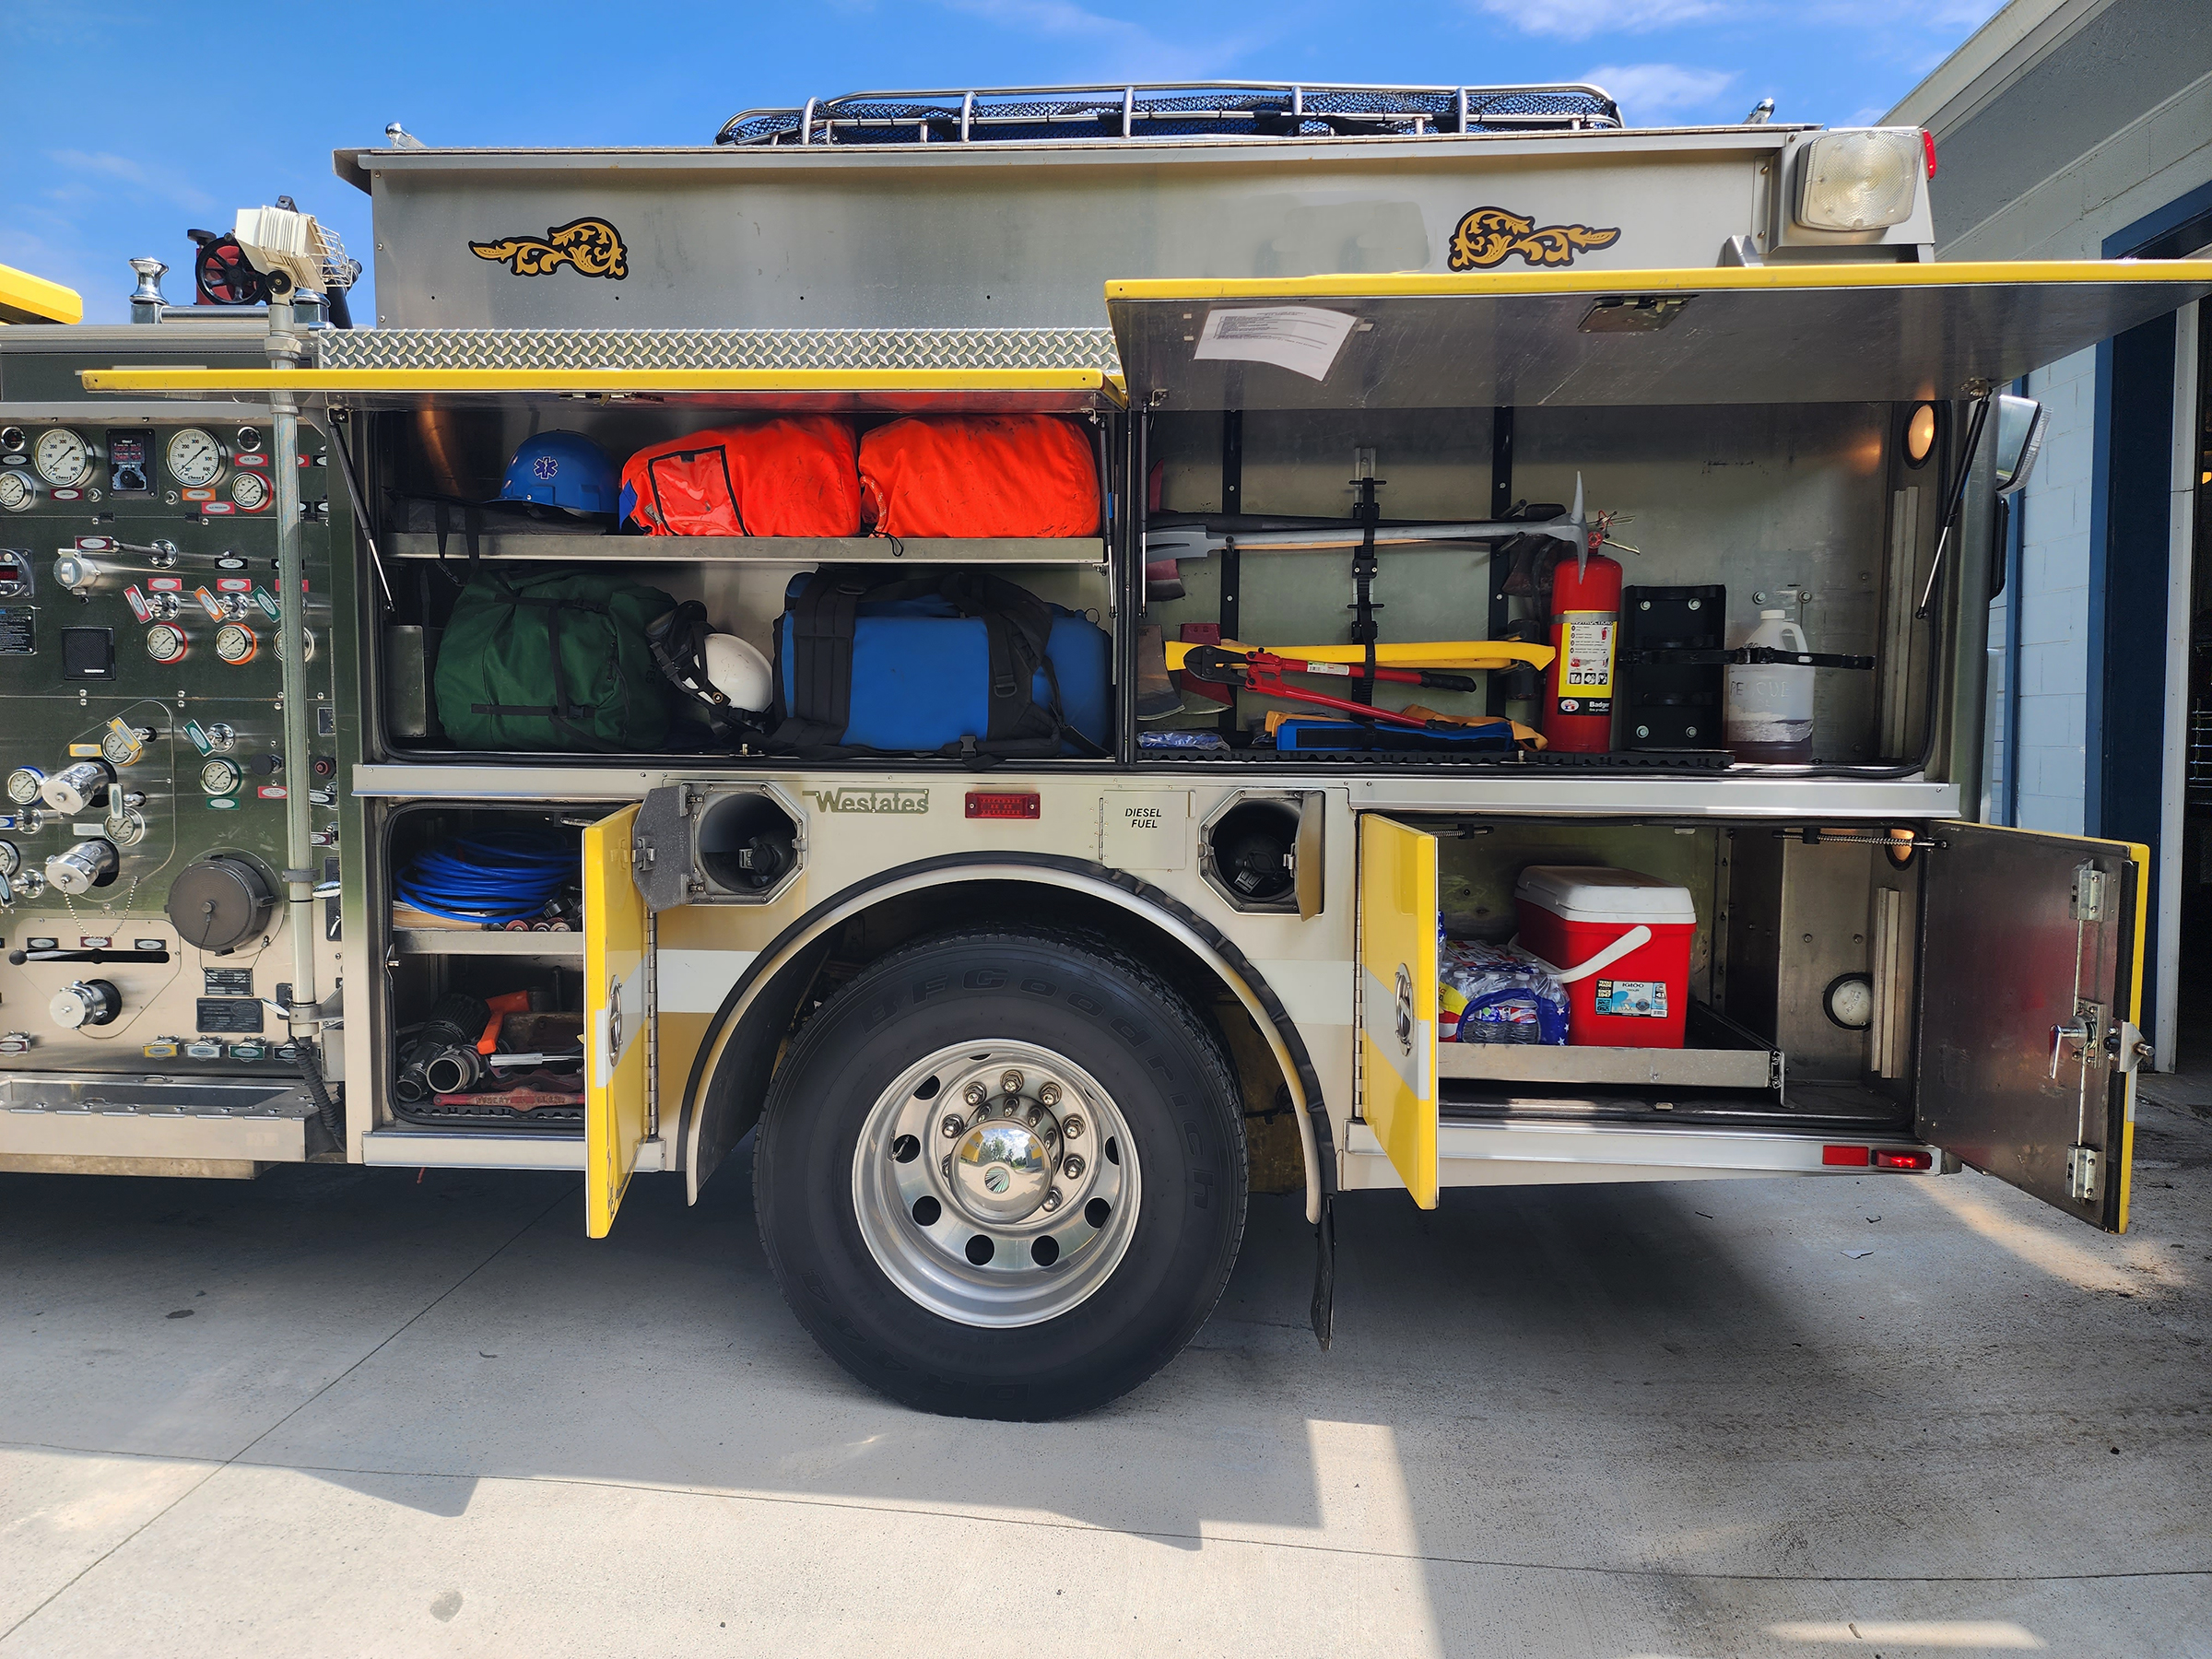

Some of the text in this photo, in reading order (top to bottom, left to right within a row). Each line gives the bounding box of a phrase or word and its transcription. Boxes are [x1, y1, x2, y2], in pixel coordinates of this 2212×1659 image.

[802, 787, 929, 815] Westates
[1124, 808, 1162, 818] DIESEL
[1131, 819, 1158, 829] FUEL
[860, 967, 1215, 1210] BFGoodrich
